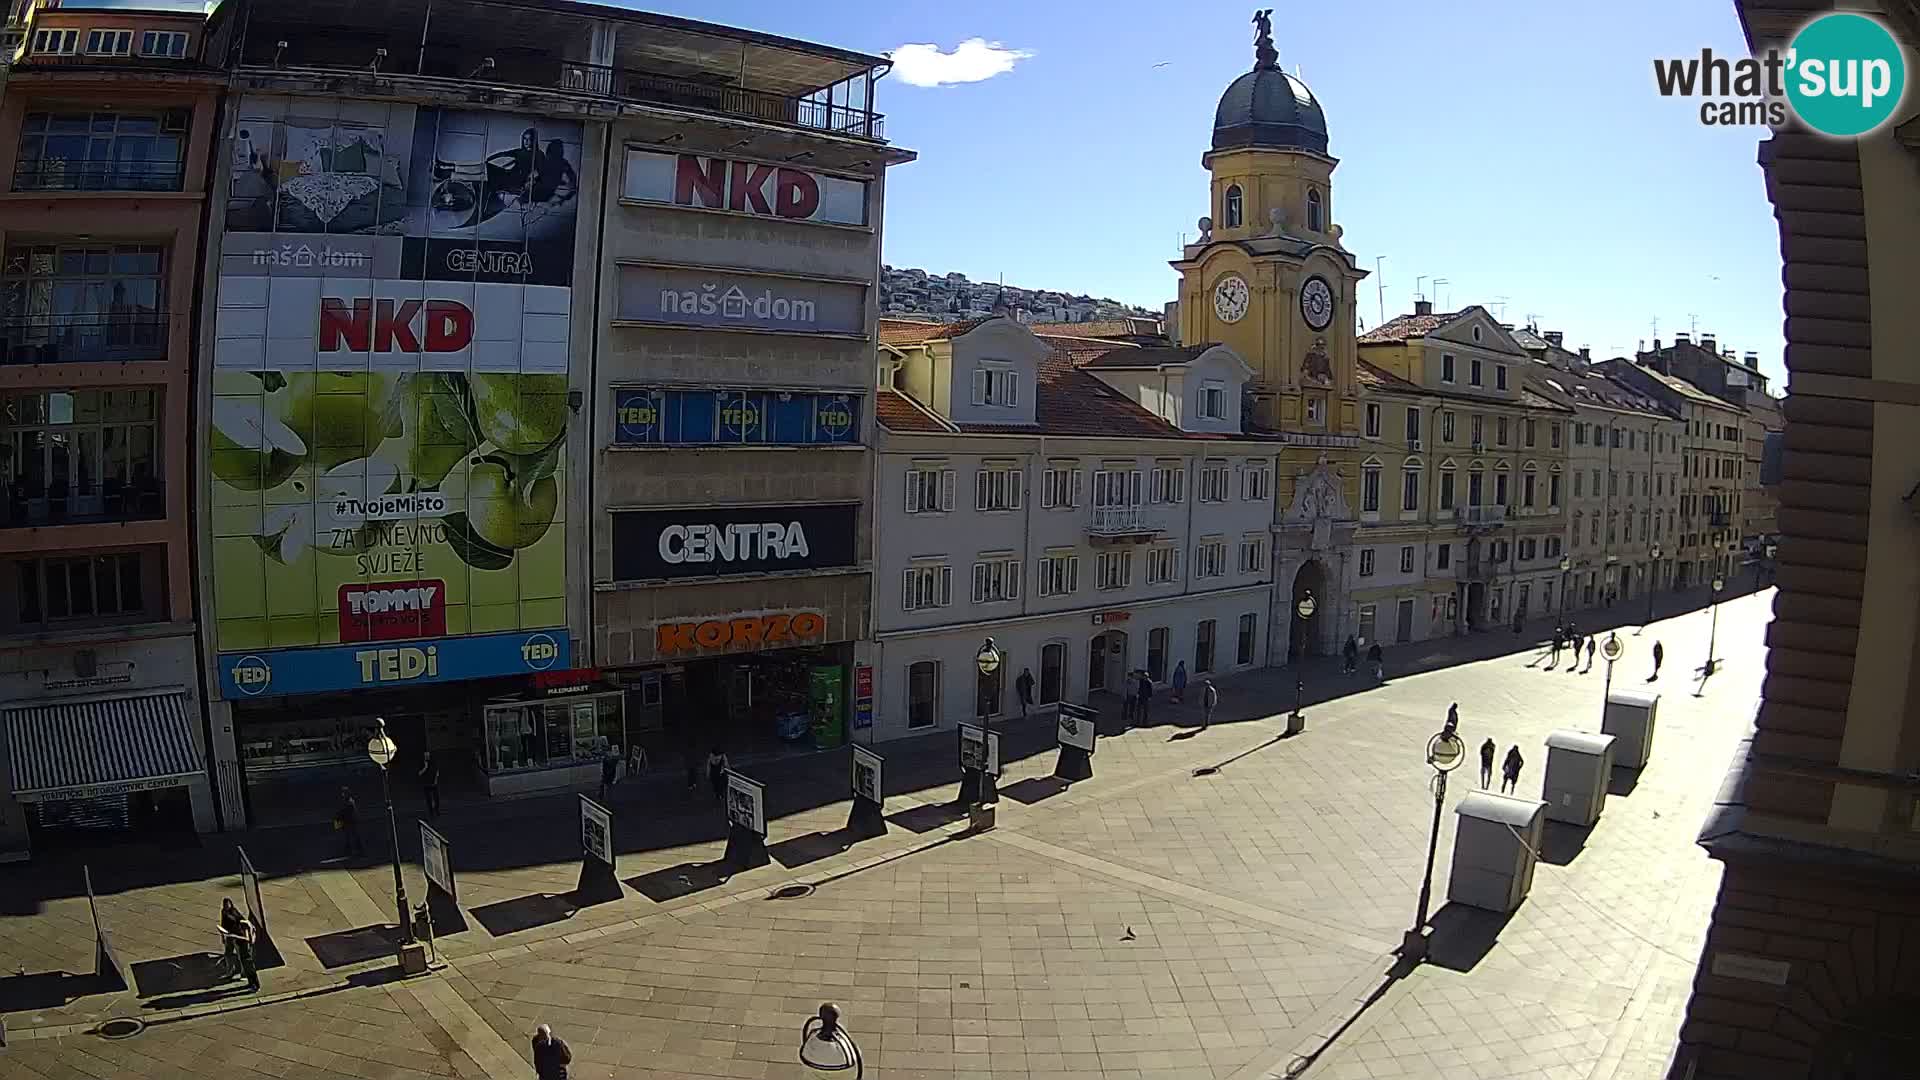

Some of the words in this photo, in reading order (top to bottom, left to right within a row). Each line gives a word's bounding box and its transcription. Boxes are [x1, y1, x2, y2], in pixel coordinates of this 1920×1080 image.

[676, 155, 820, 220] NKD
[253, 245, 292, 266] naš
[319, 245, 364, 267] dom
[446, 249, 533, 274] CENTRA
[660, 284, 715, 316] naš
[754, 288, 815, 322] dom
[319, 297, 475, 353] NKD
[617, 407, 657, 425] TEDi
[722, 408, 759, 425] TEDi
[336, 497, 444, 517] #TvojeMisto
[331, 528, 356, 549] ZA
[364, 524, 448, 548] DNEVNO
[658, 521, 809, 565] CENTRA
[357, 548, 425, 575] SVJEŽE
[347, 587, 437, 615] TOMMY
[656, 612, 826, 653] KORZO
[355, 645, 438, 683] TEDi
[520, 642, 558, 661] TEDi
[231, 664, 271, 685] TEDi
